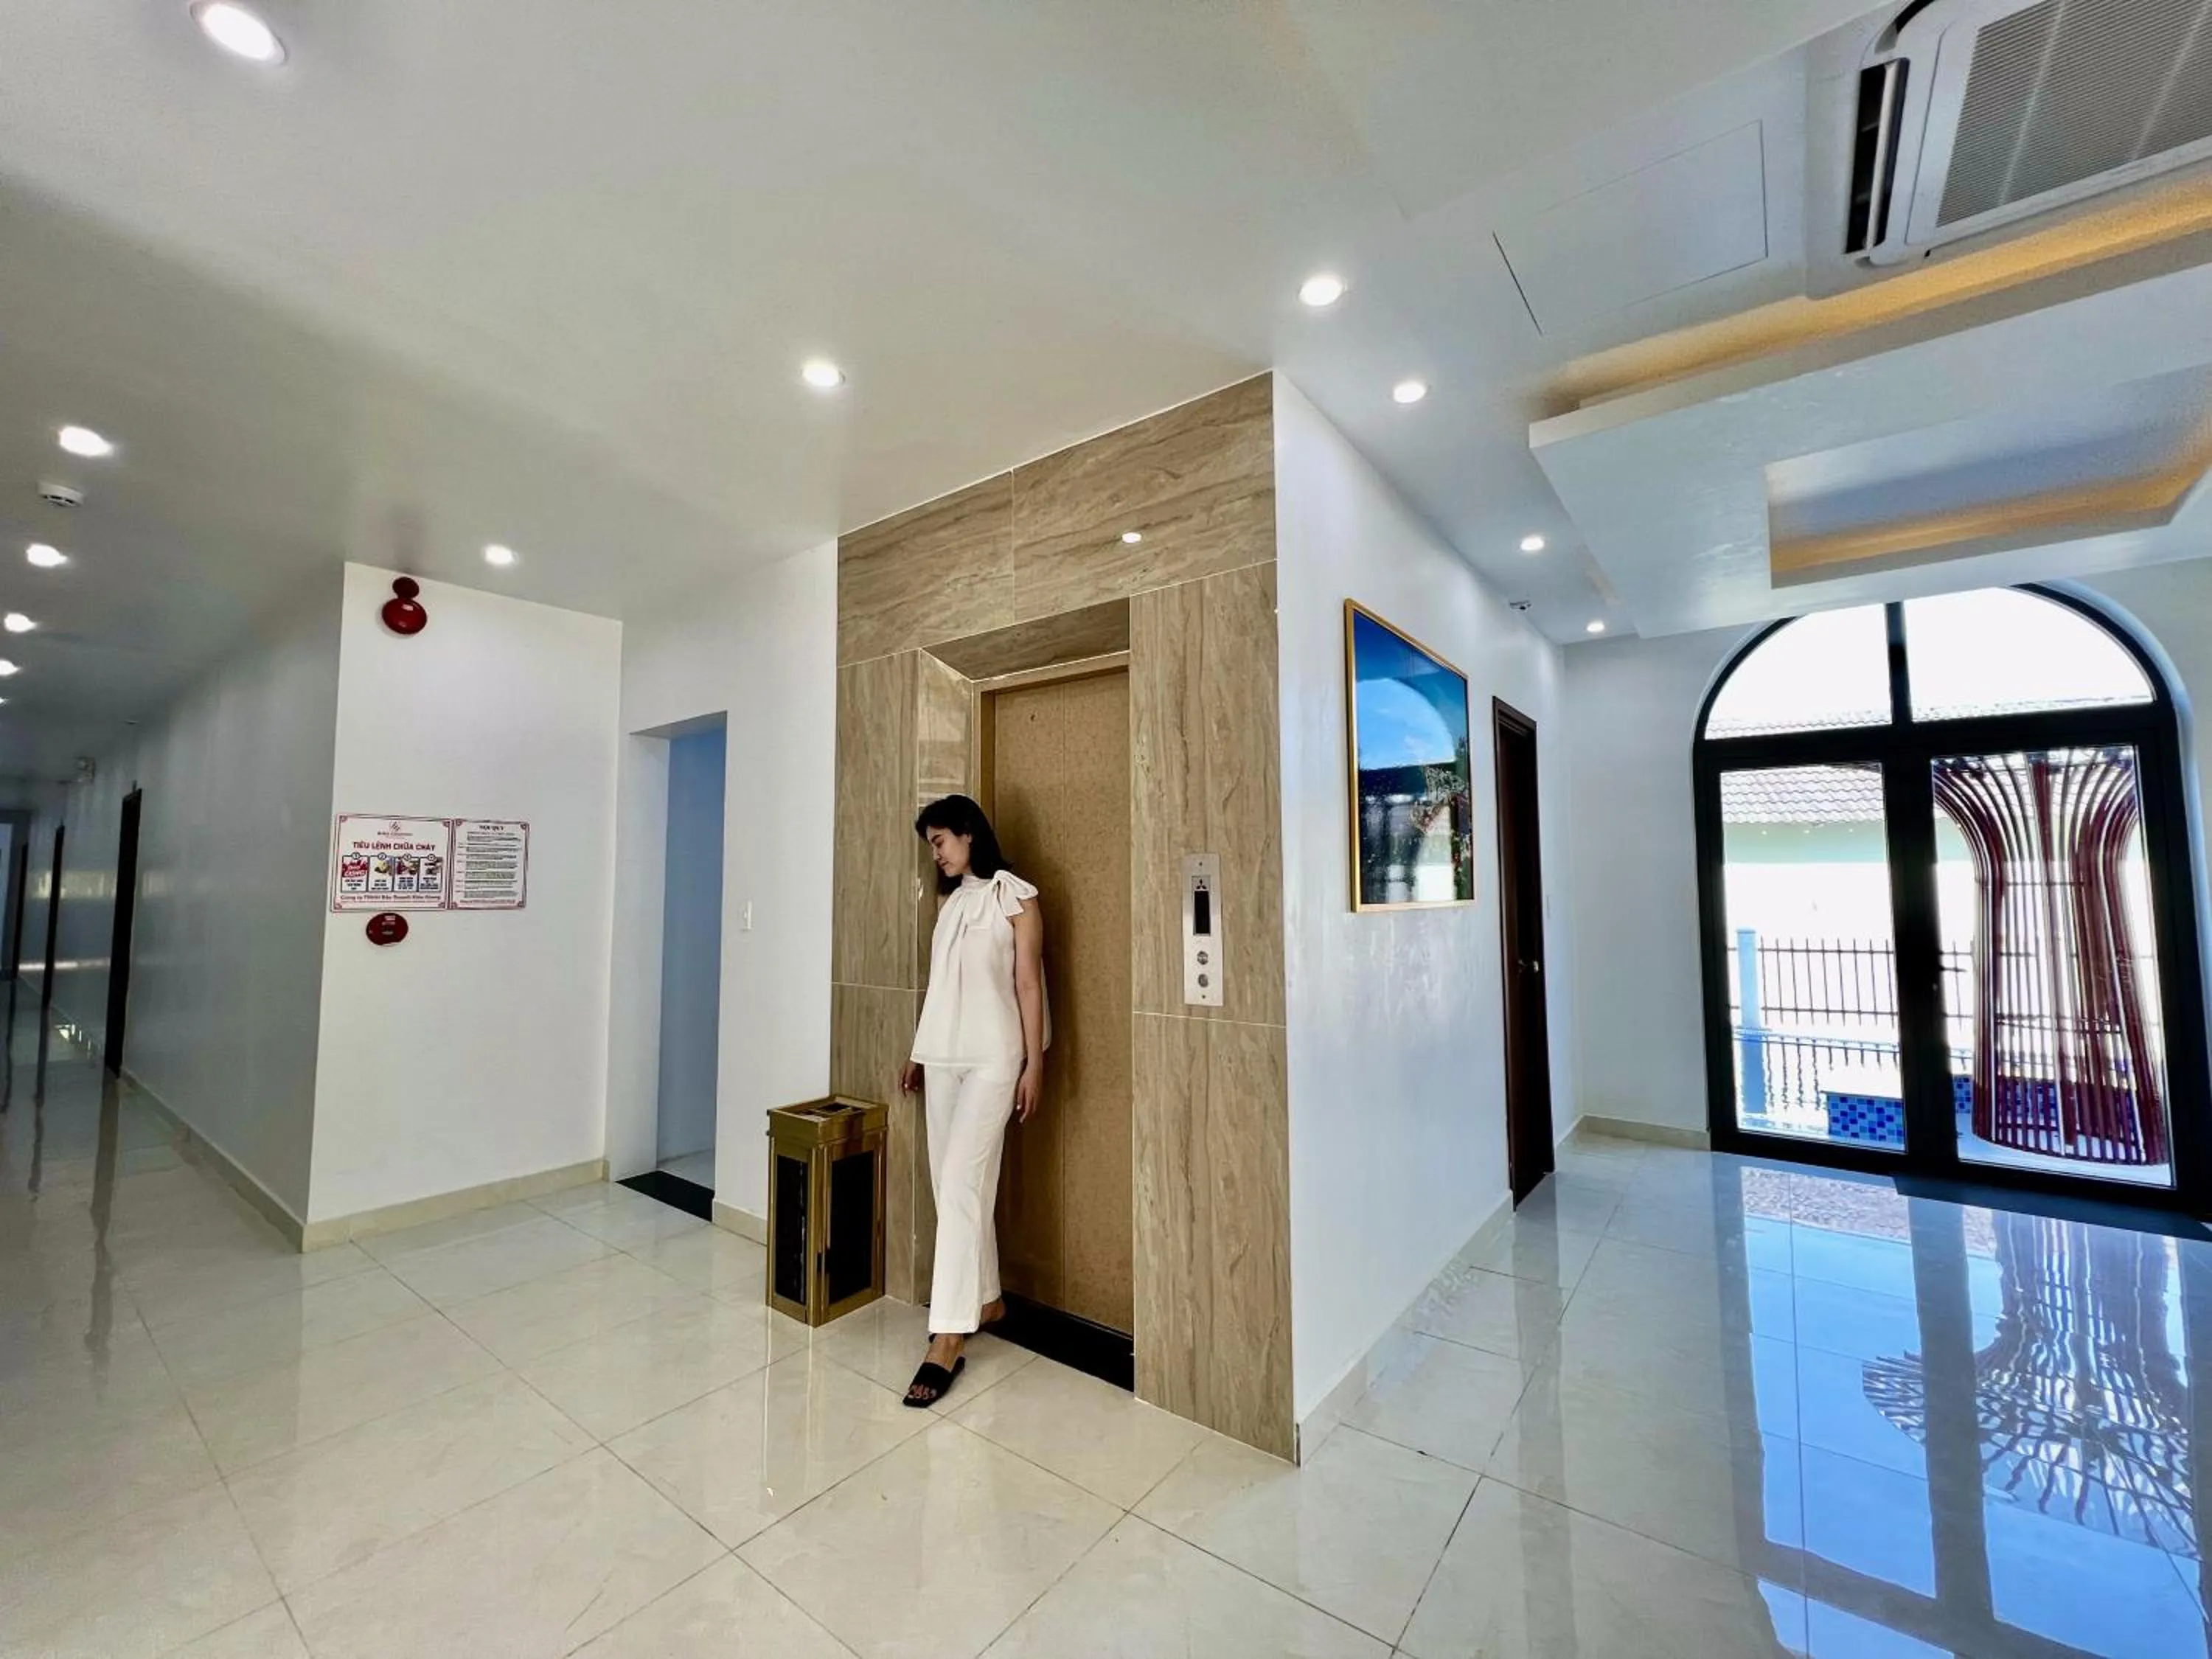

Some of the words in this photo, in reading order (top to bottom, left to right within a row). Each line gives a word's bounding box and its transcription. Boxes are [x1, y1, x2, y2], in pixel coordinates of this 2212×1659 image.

[353, 840, 369, 849] TIÊU
[394, 841, 414, 850] CHỮA
[415, 842, 436, 851] CHÁY
